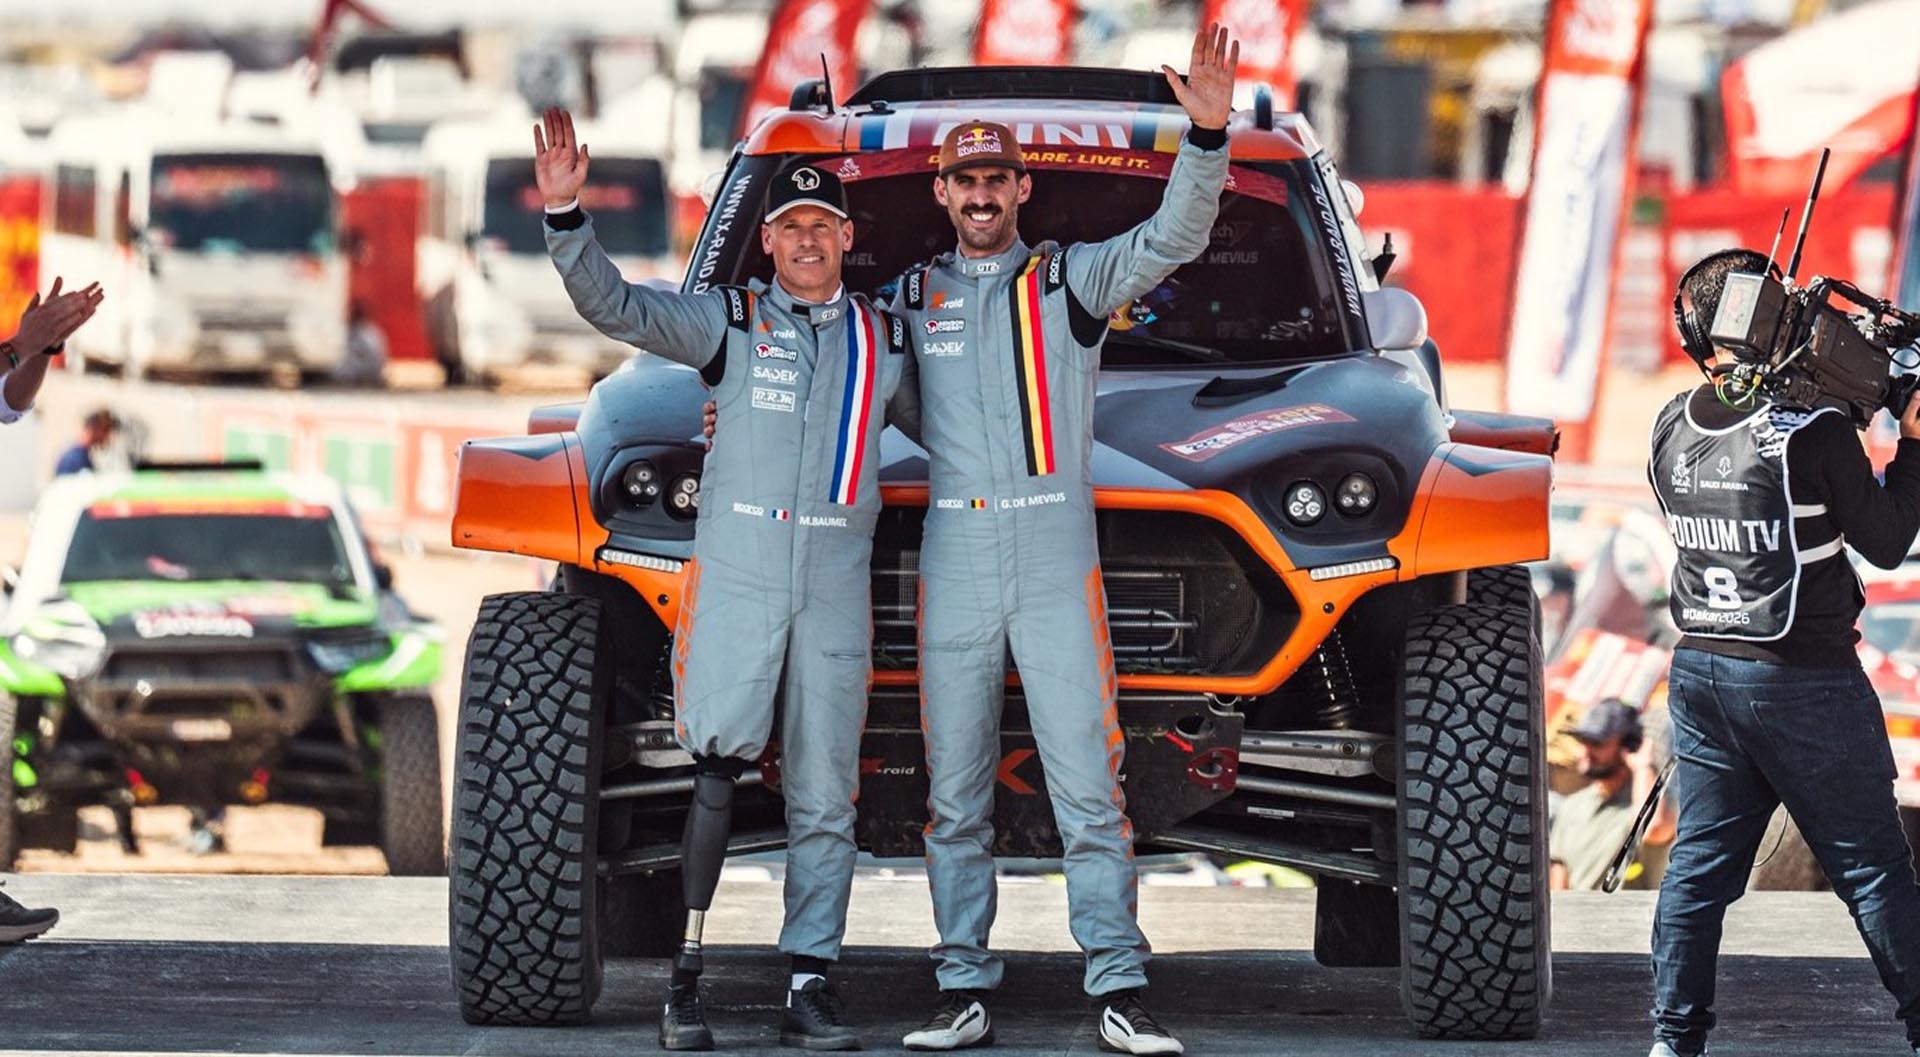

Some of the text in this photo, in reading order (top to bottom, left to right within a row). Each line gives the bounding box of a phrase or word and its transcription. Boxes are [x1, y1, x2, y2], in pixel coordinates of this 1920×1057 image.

[1078, 154, 1123, 165] LIVE
[1127, 159, 1150, 169] IT.
[693, 174, 753, 295] WWW.X-RAID.D
[1209, 251, 1259, 265] MEVIUS
[1311, 183, 1361, 317] WWW.X-RAID.DE
[1700, 480, 1749, 491] SAUDI ARABIA
[1028, 492, 1066, 506] MEVIUS
[1742, 519, 1780, 553] TV
[1703, 566, 1743, 610] 8
[1682, 607, 1750, 625] #Dakar2026
